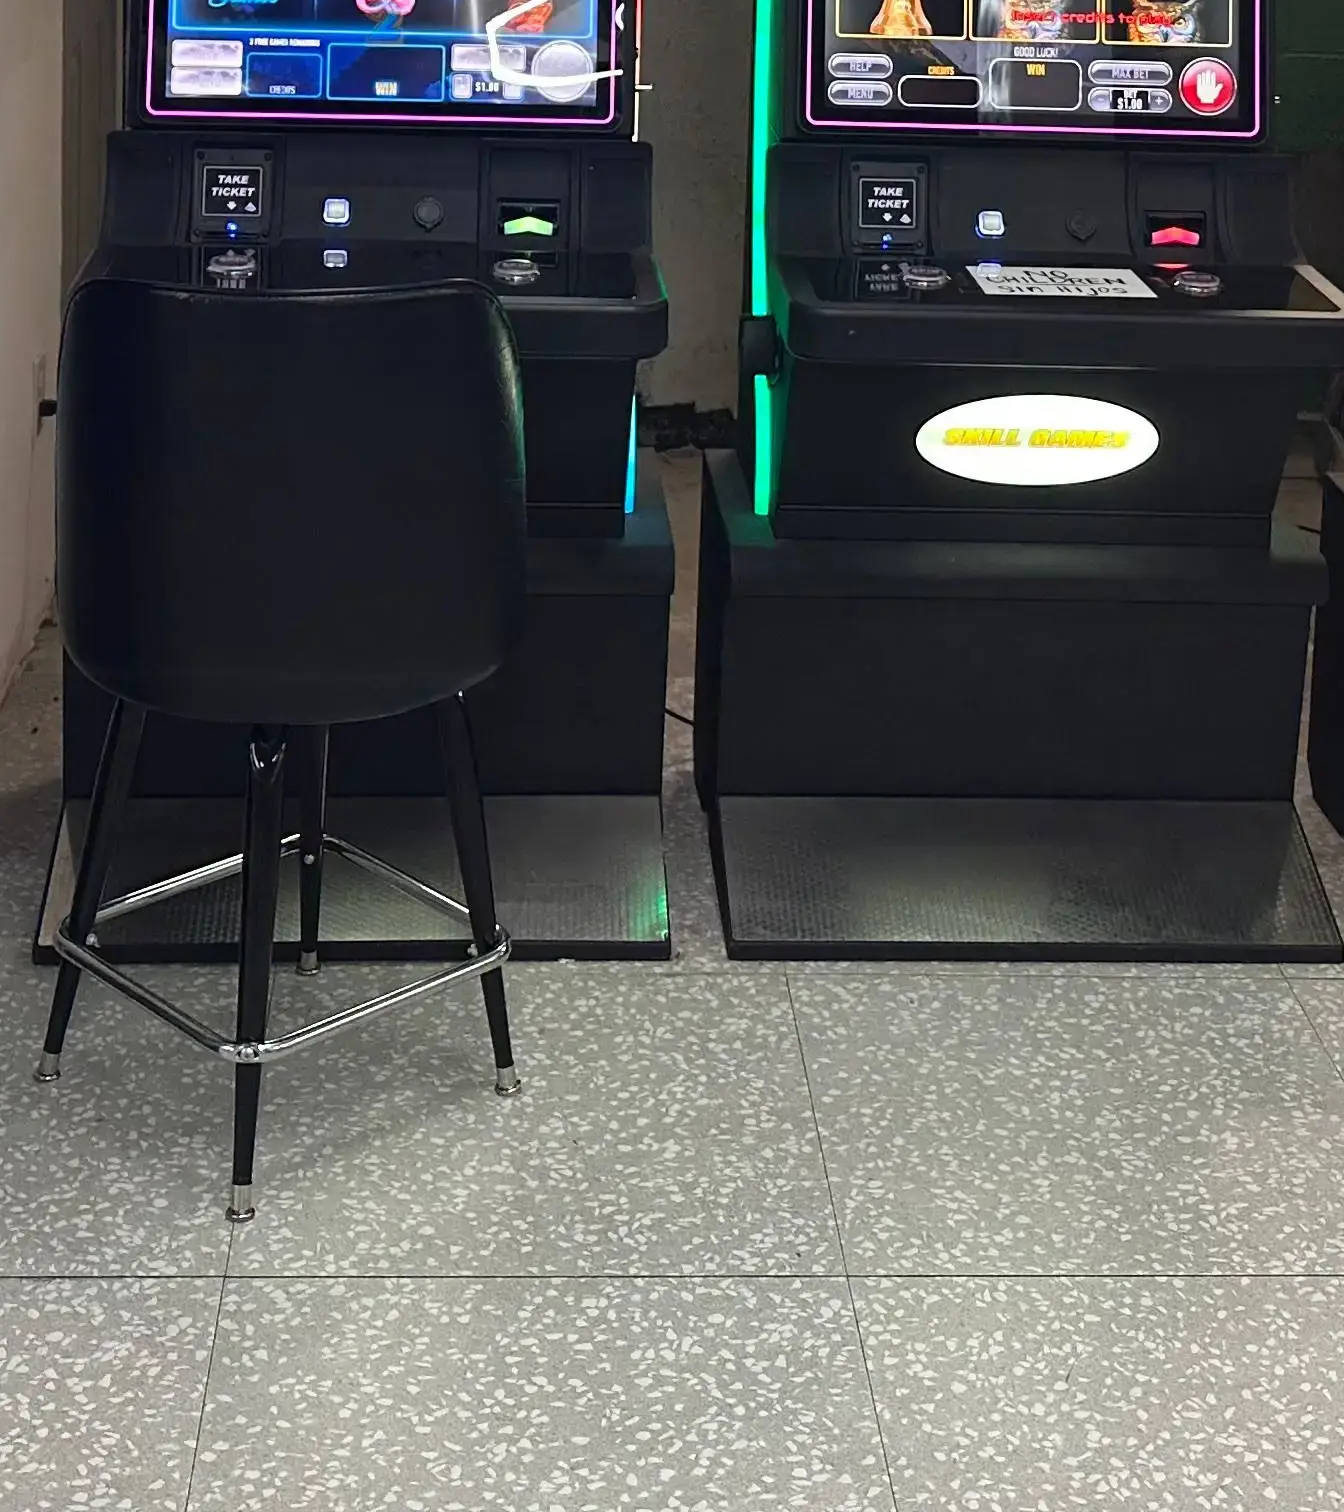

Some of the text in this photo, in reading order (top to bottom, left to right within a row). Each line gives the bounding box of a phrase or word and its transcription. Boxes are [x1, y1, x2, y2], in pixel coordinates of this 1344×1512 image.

[1061, 11, 1136, 24] credits to
[1014, 46, 1058, 58] GOOD LUCK!
[849, 60, 872, 72] HELP
[1026, 64, 1046, 76] WIN
[1112, 67, 1132, 80] MAX
[848, 88, 873, 99] MENU
[1117, 97, 1143, 110] $1.00
[218, 175, 249, 184] TAKE
[211, 187, 256, 197] TICKET
[873, 187, 904, 197] TAKE
[867, 199, 910, 208] TICKET
[986, 274, 1127, 287] CHILDREN
[1023, 270, 1069, 282] NO
[943, 428, 1022, 448] SKILL
